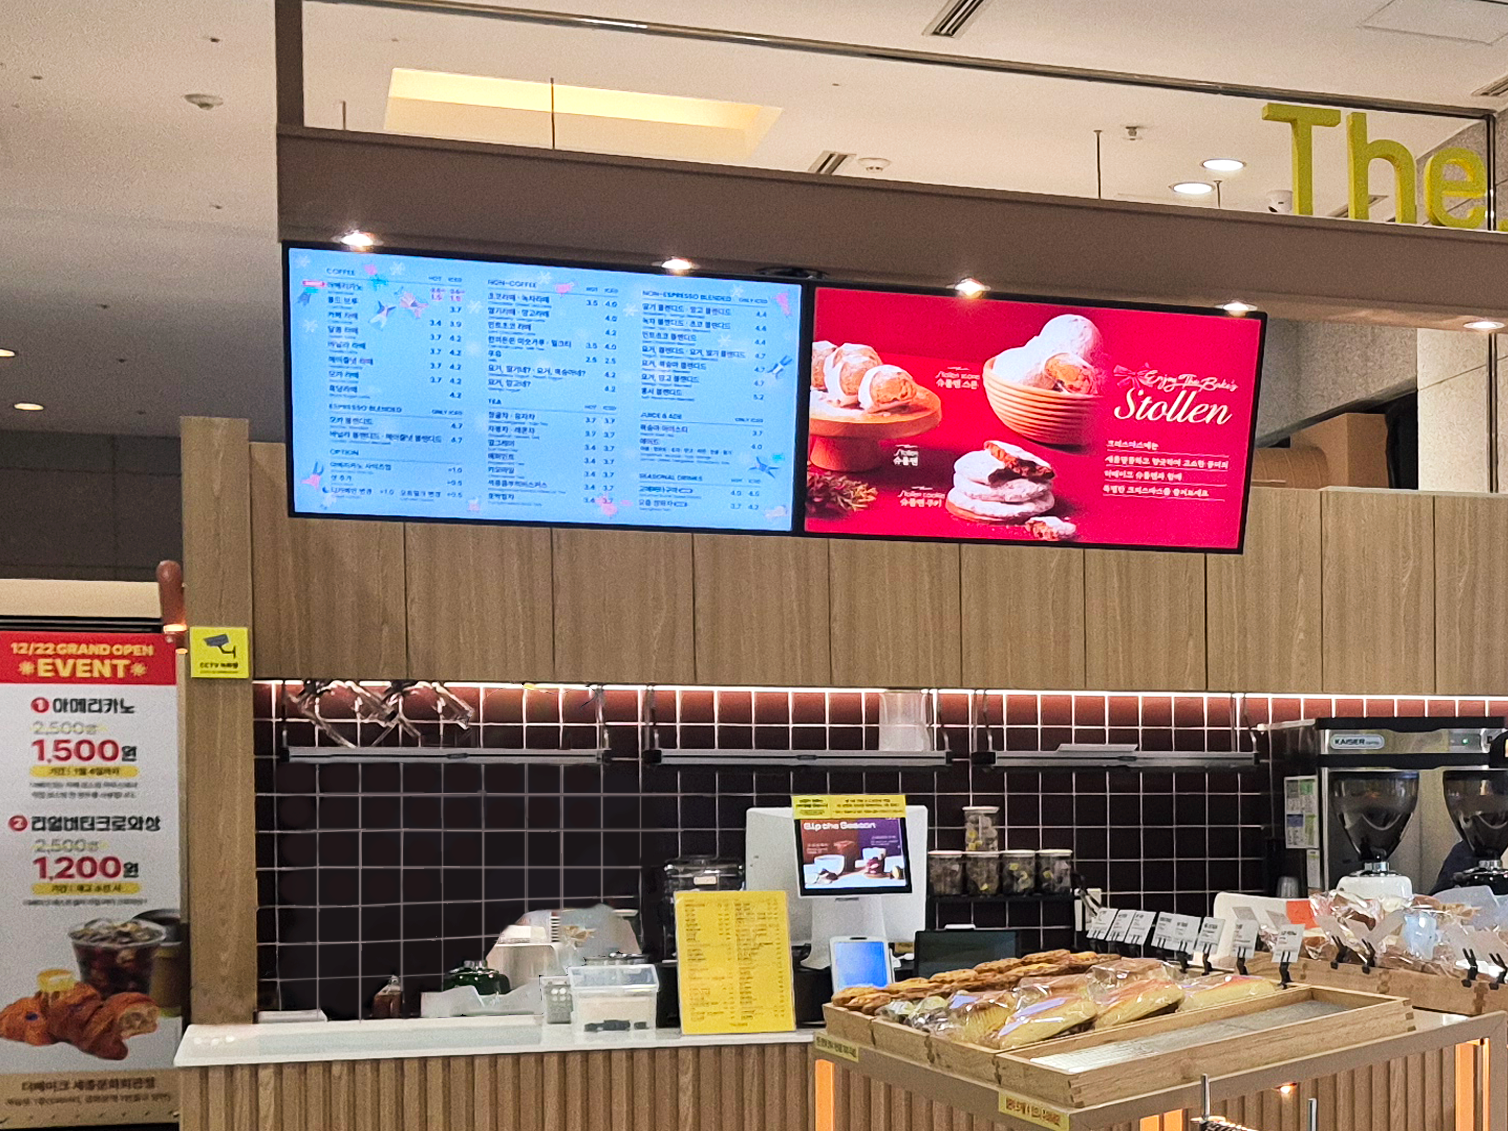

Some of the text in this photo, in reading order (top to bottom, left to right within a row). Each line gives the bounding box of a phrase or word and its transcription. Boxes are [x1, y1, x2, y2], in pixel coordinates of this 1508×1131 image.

[1145, 369, 1178, 392] Enjoy
[1114, 387, 1233, 424] Stollen
[11, 642, 154, 656] 12/22 GRAND OPEN
[38, 660, 131, 678] EVENT
[53, 698, 135, 714] 아메리카노
[31, 739, 137, 764] 1,500원
[32, 857, 138, 880] 1,200원
